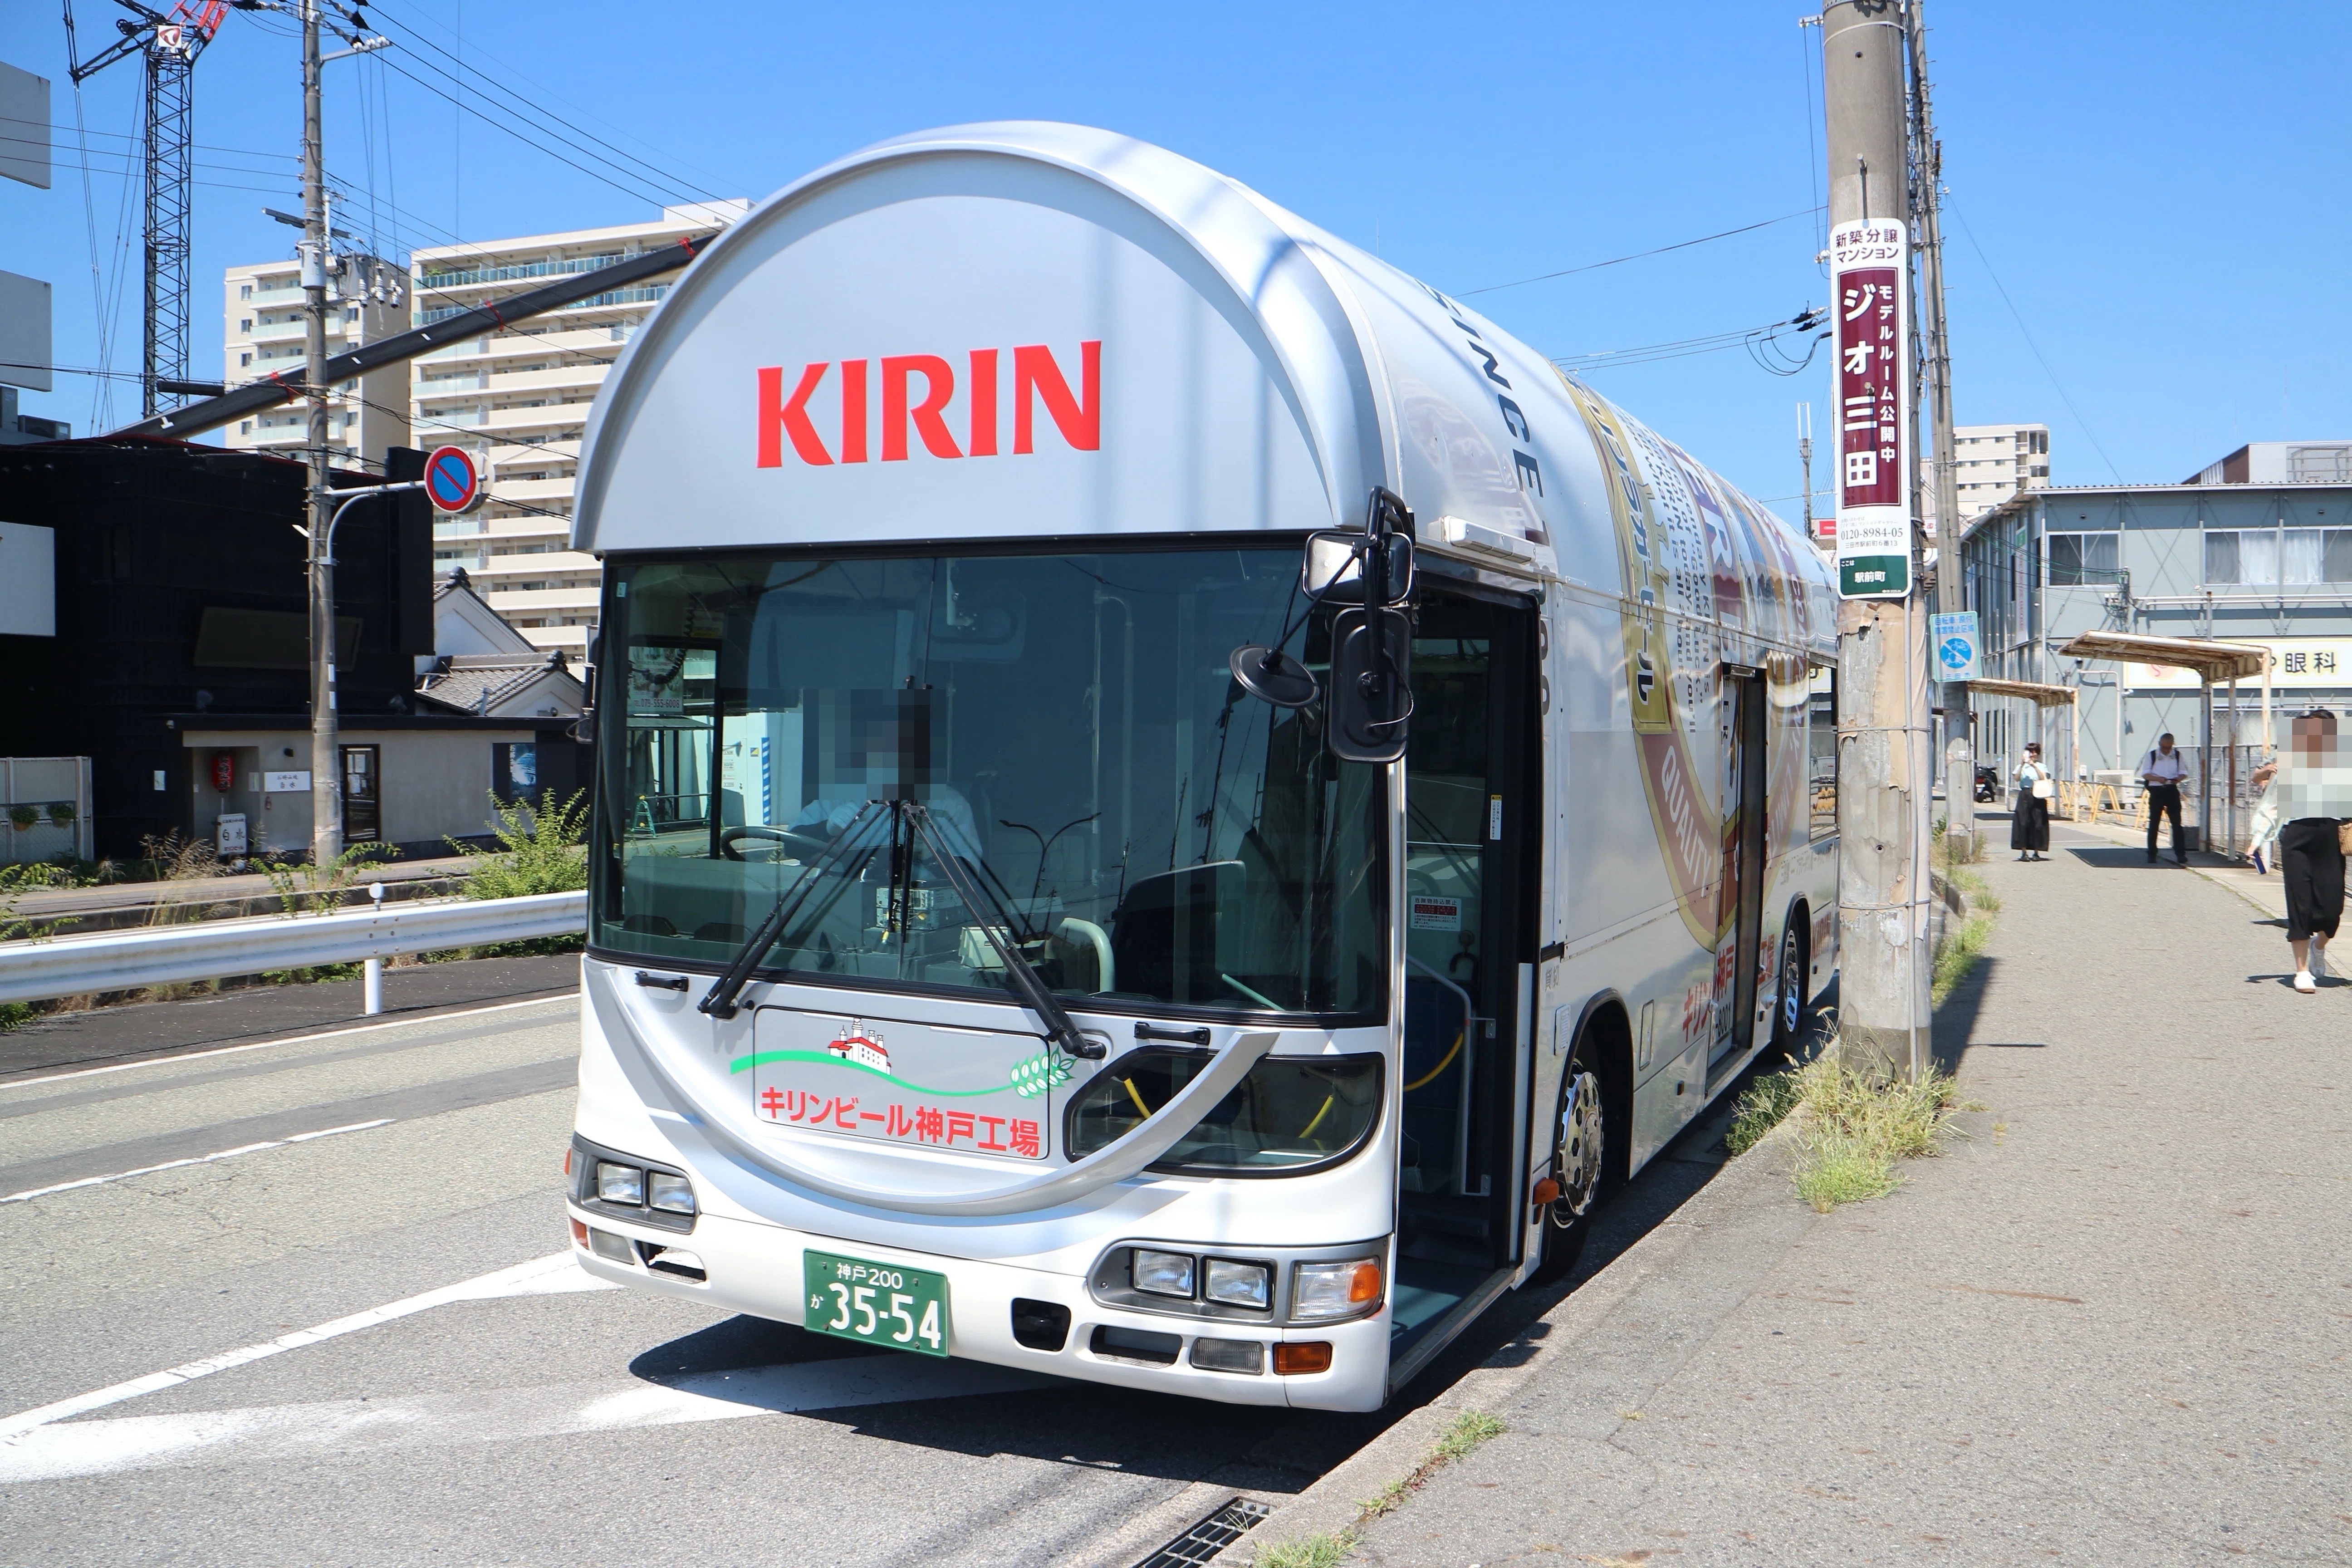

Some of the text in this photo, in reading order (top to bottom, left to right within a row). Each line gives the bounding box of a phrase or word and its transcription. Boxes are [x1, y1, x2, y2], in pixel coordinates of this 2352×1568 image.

[1836, 228, 1898, 248] 新築分譲
[1837, 247, 1899, 263] マンション
[757, 341, 1101, 468] KIRIN
[1414, 278, 1544, 498] SINCE
[1843, 283, 1877, 489] ジオ三田
[1878, 285, 1896, 462] モデルルーム公開中
[1564, 371, 1655, 705] キリンラガービール
[1645, 456, 1670, 510] what
[1666, 517, 1676, 533] it
[1672, 540, 1679, 559] is
[1676, 567, 1684, 596] all
[1656, 464, 1684, 531] KIRIN
[1680, 539, 1693, 610] today,
[1681, 511, 1692, 534] of
[1841, 528, 1903, 540] 0120-8984-05
[1845, 540, 1898, 549] 三田市駅前町6番13
[1669, 467, 1706, 586] legendary
[1704, 674, 1710, 693] is
[1854, 571, 1886, 583] 駅前町
[1661, 745, 1712, 897] QUALITY
[761, 1086, 1040, 1157] キリンビール神戸工場
[811, 1282, 941, 1349] か 35-54
[837, 1262, 902, 1289] 神戸200
